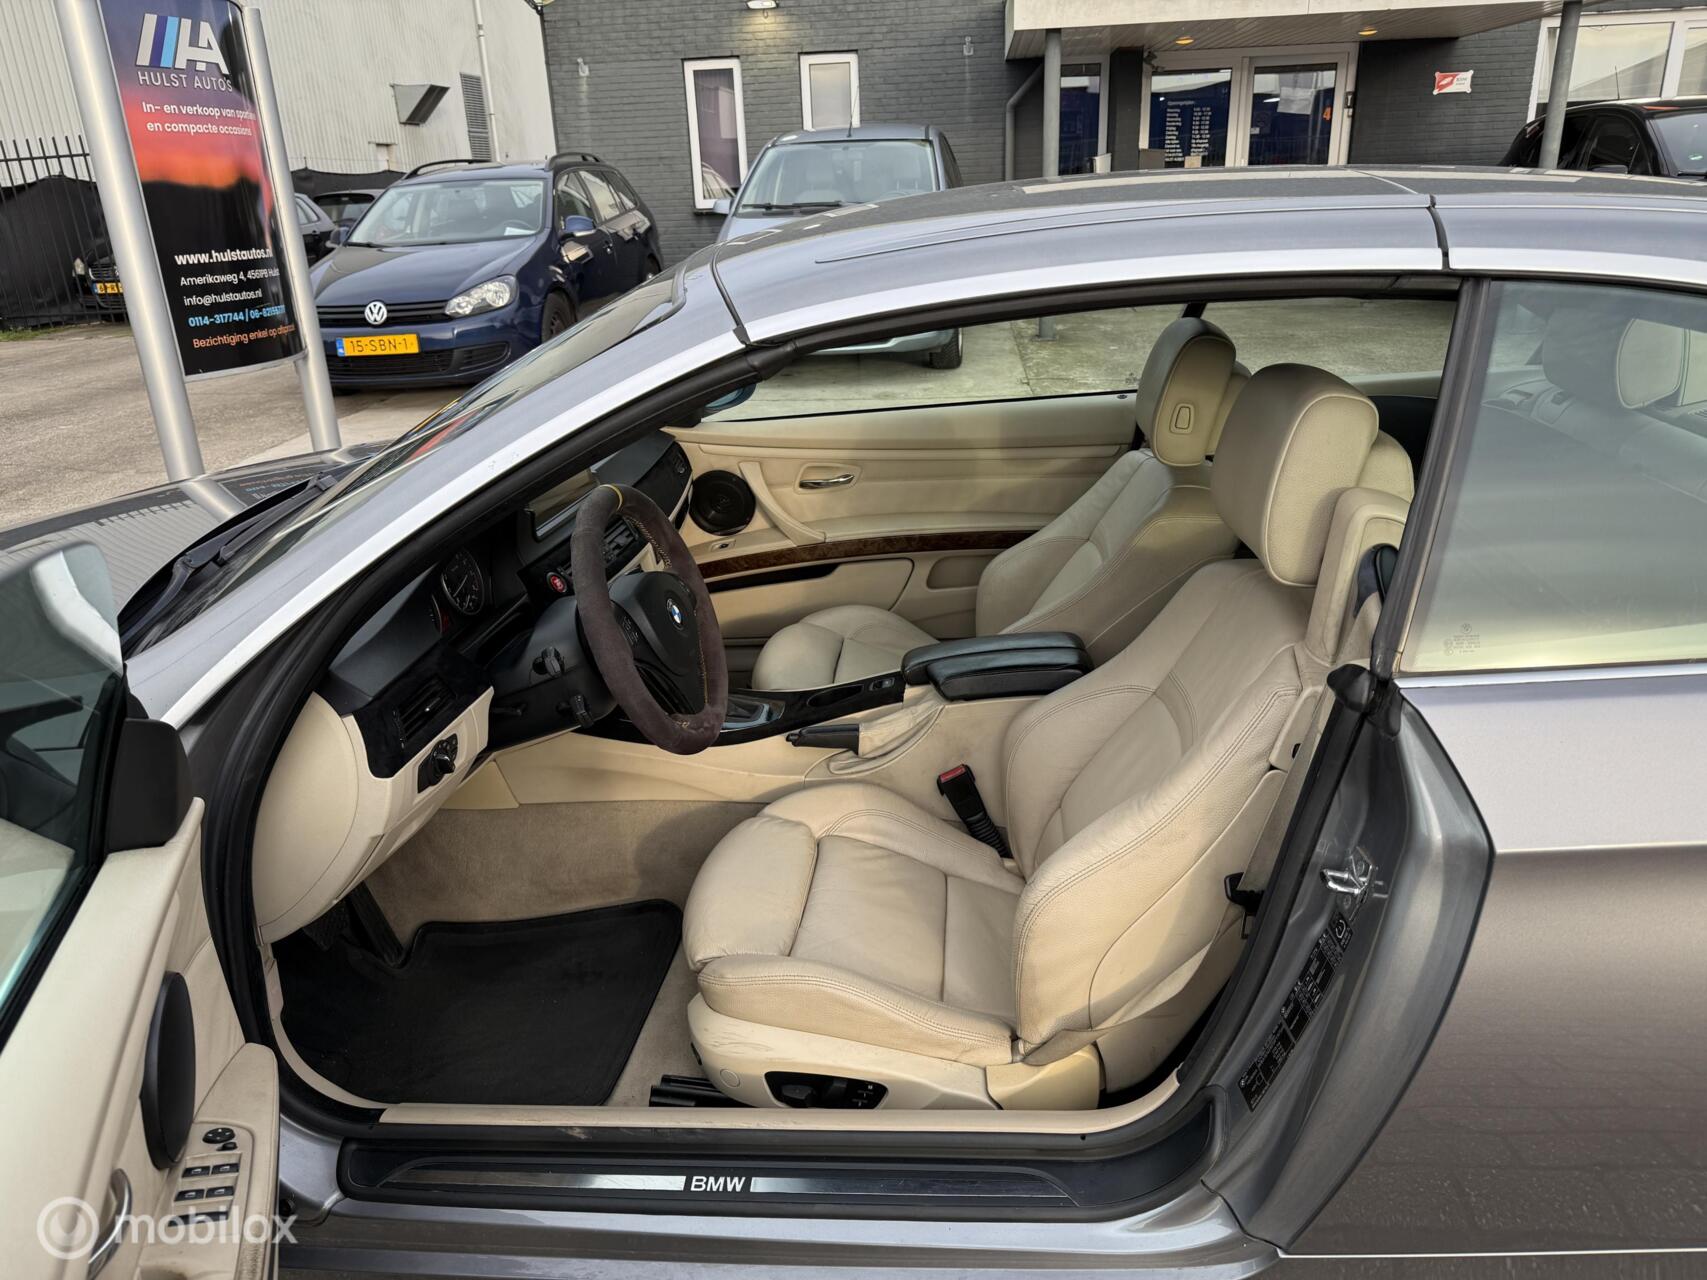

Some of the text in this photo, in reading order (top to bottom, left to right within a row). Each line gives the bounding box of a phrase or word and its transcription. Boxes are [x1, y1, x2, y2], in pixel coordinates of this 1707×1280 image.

[138, 71, 187, 88] HULST
[142, 101, 161, 114] In-
[163, 103, 179, 114] en
[180, 105, 220, 119] verkoop
[221, 107, 236, 117] van
[146, 121, 163, 132] en
[164, 122, 219, 136] compacte
[174, 248, 273, 265] www.hulstautos.nl
[180, 272, 239, 287] Amerikaweg
[183, 288, 263, 307] info@hulstautos.nl
[189, 313, 244, 327] 0114-317744
[193, 332, 249, 349] Bezichtiging
[350, 338, 409, 353] 15-SBN-1
[690, 1175, 746, 1193] BMW
